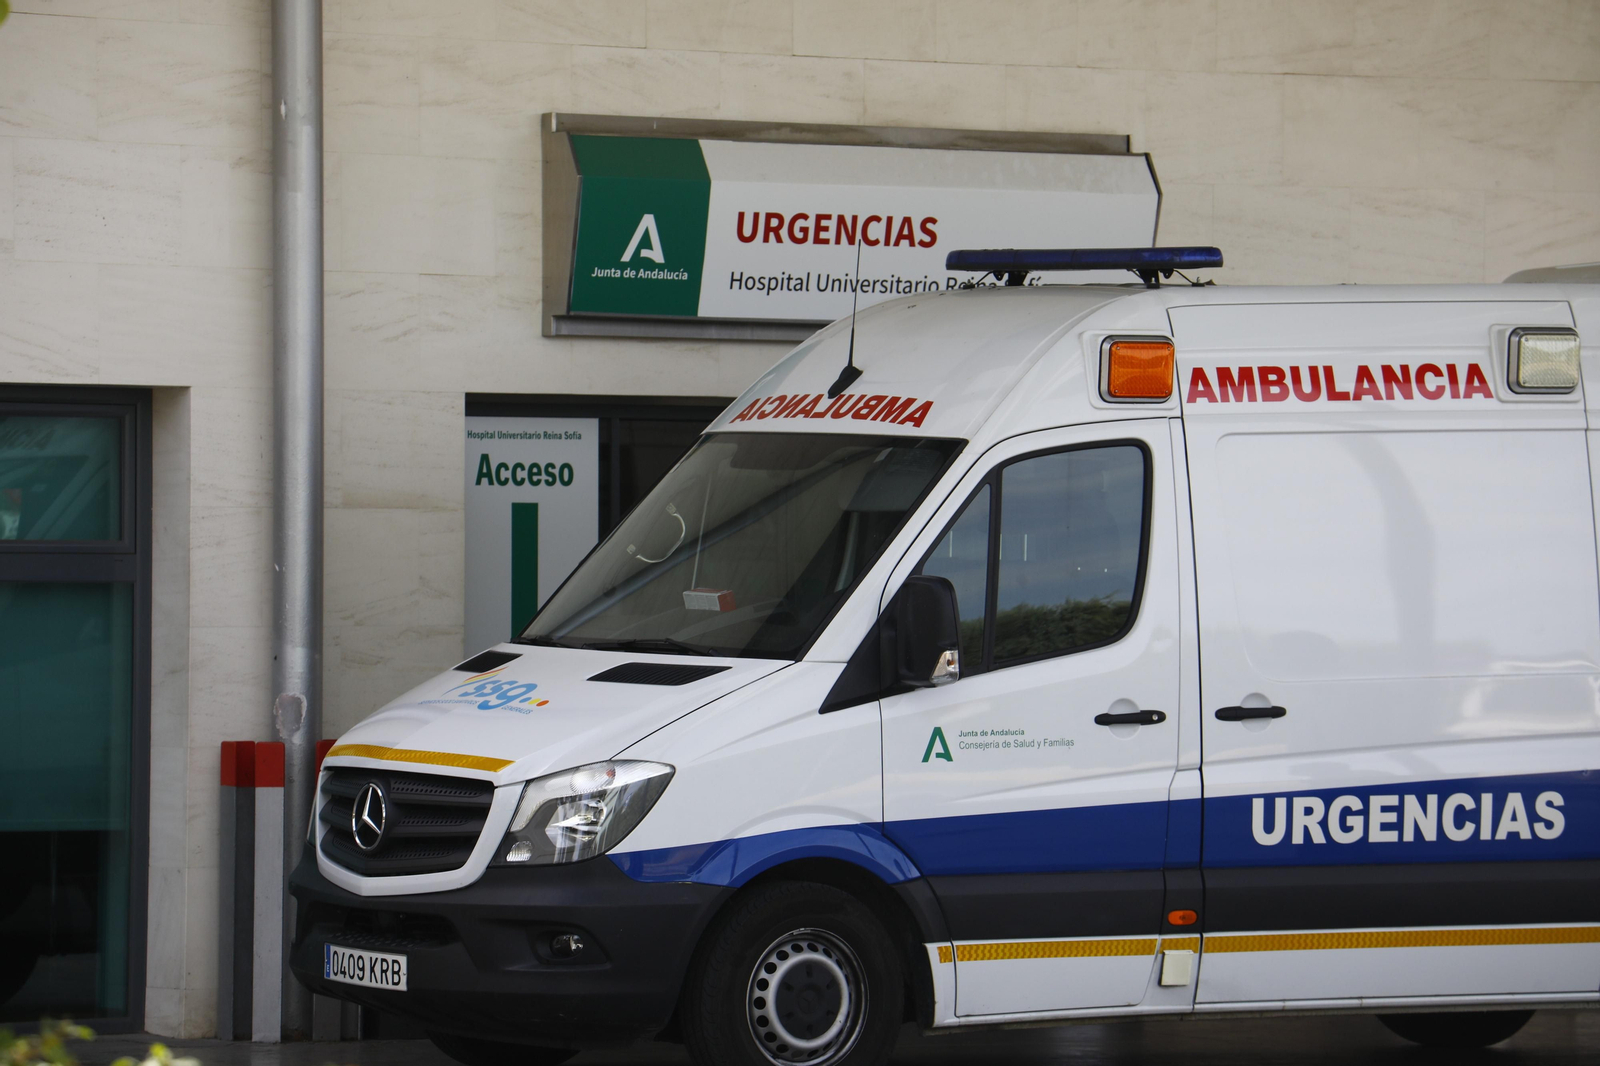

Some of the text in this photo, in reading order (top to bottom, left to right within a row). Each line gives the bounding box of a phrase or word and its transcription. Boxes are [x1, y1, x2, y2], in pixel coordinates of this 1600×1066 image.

[737, 211, 938, 248] URGENCIAS
[591, 266, 688, 280] Junta de Andalucía
[729, 271, 811, 296] Hospital
[816, 273, 940, 294] Universitario
[1186, 362, 1494, 403] AMBULANCIA
[467, 430, 496, 441] Hospital
[497, 430, 542, 440] Universitario
[543, 430, 562, 440] Reina
[475, 453, 574, 487] Acceso
[958, 728, 1025, 738] Junta de Andalucía
[958, 737, 1075, 751] Consejería de Salud y Familias
[1252, 791, 1566, 846] URGENCIAS
[332, 950, 365, 982] 0409
[369, 956, 402, 986] KRB
